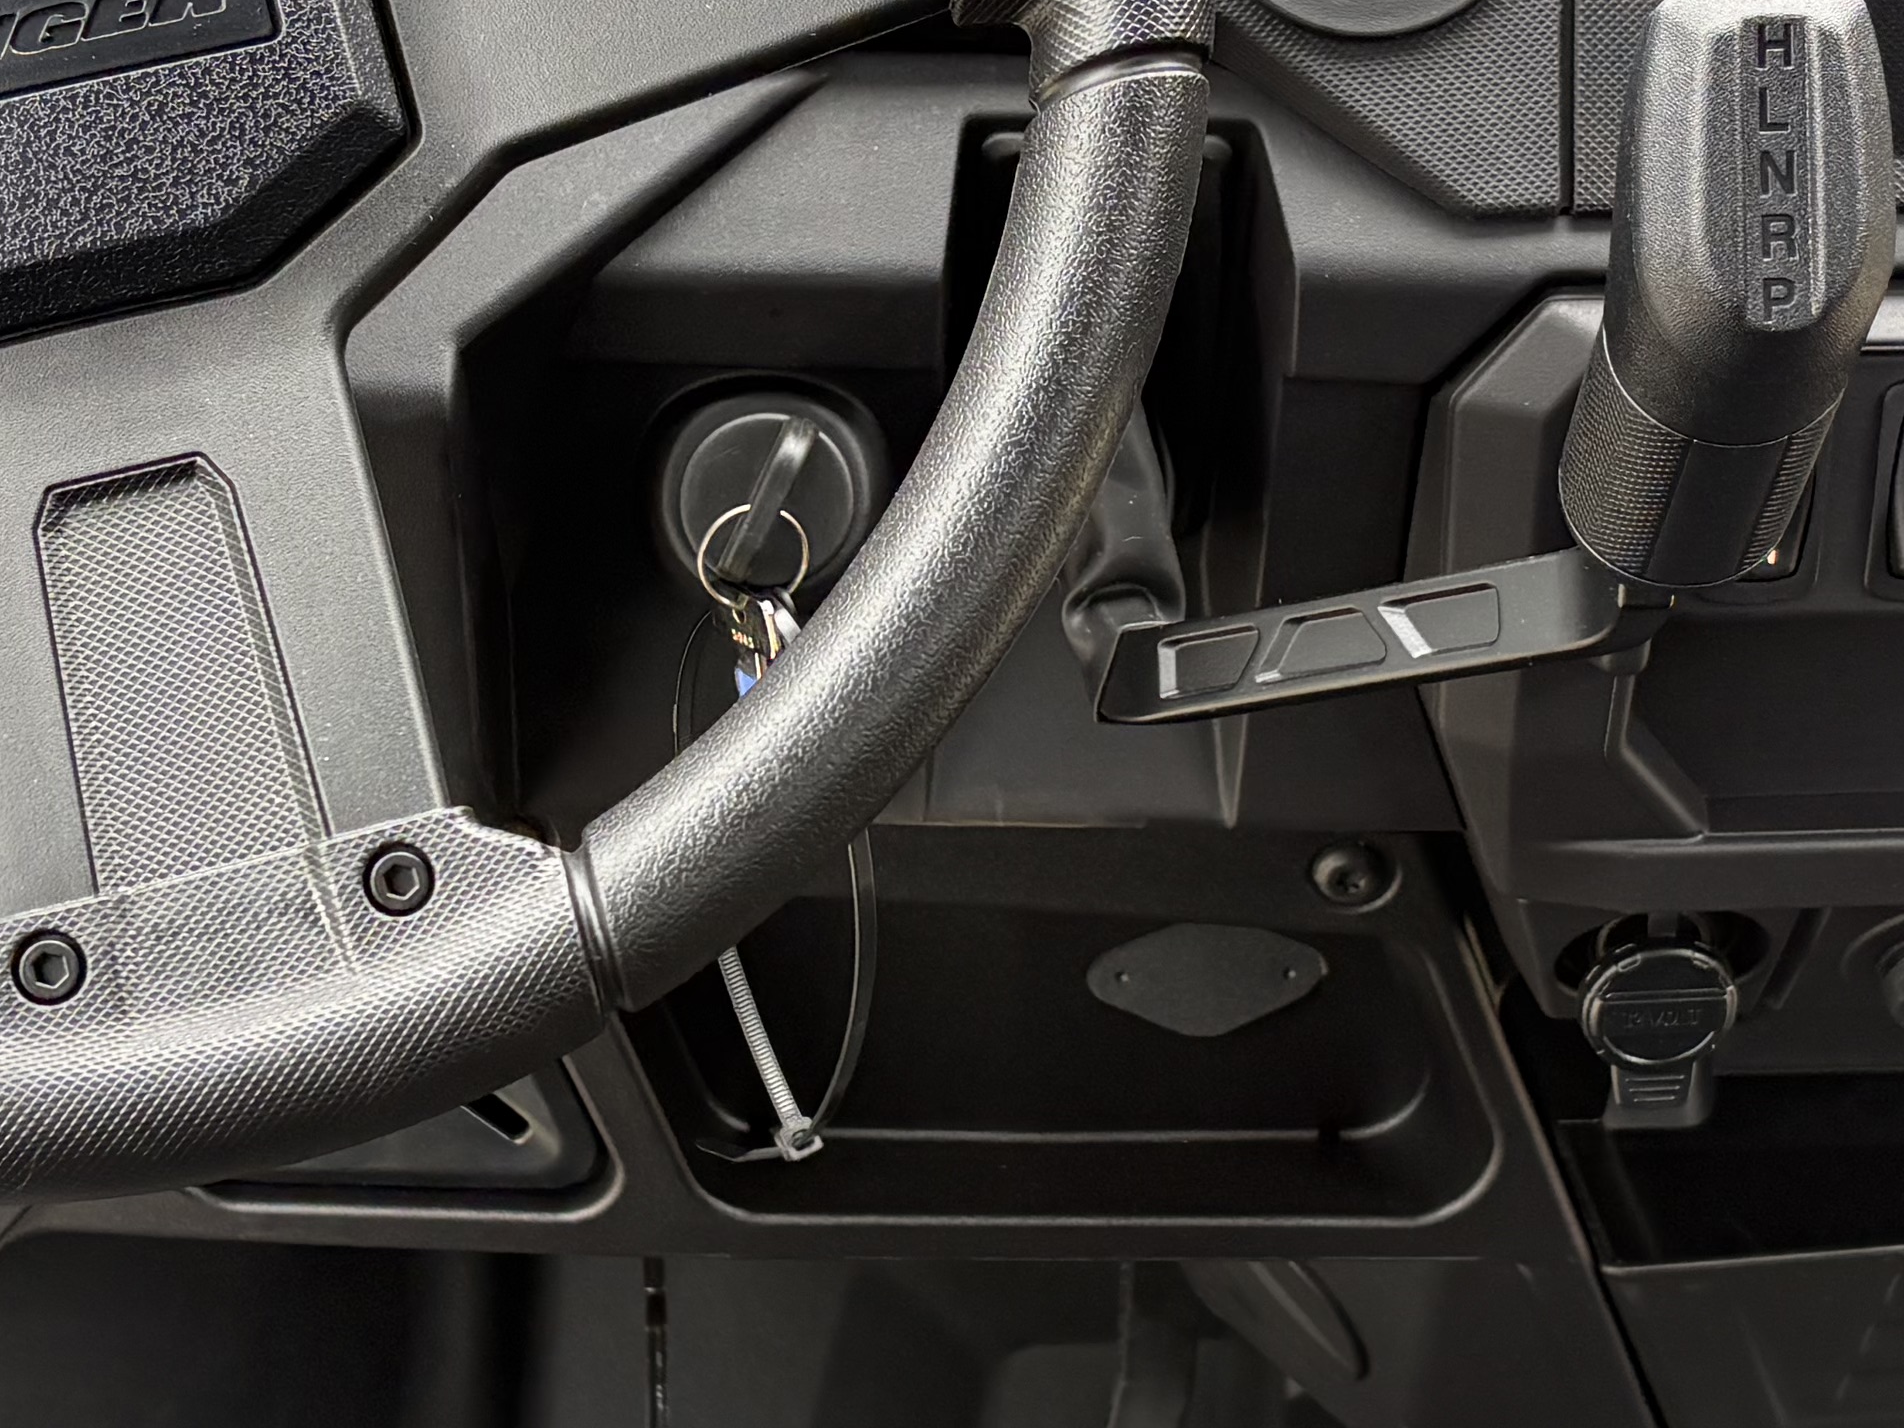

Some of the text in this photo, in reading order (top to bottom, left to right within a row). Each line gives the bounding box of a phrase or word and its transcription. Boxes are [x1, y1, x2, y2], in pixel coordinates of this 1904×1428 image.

[1756, 22, 1794, 70] H
[1758, 86, 1791, 133] L
[1760, 149, 1797, 198] N
[1761, 213, 1798, 261] R
[1762, 277, 1796, 323] P
